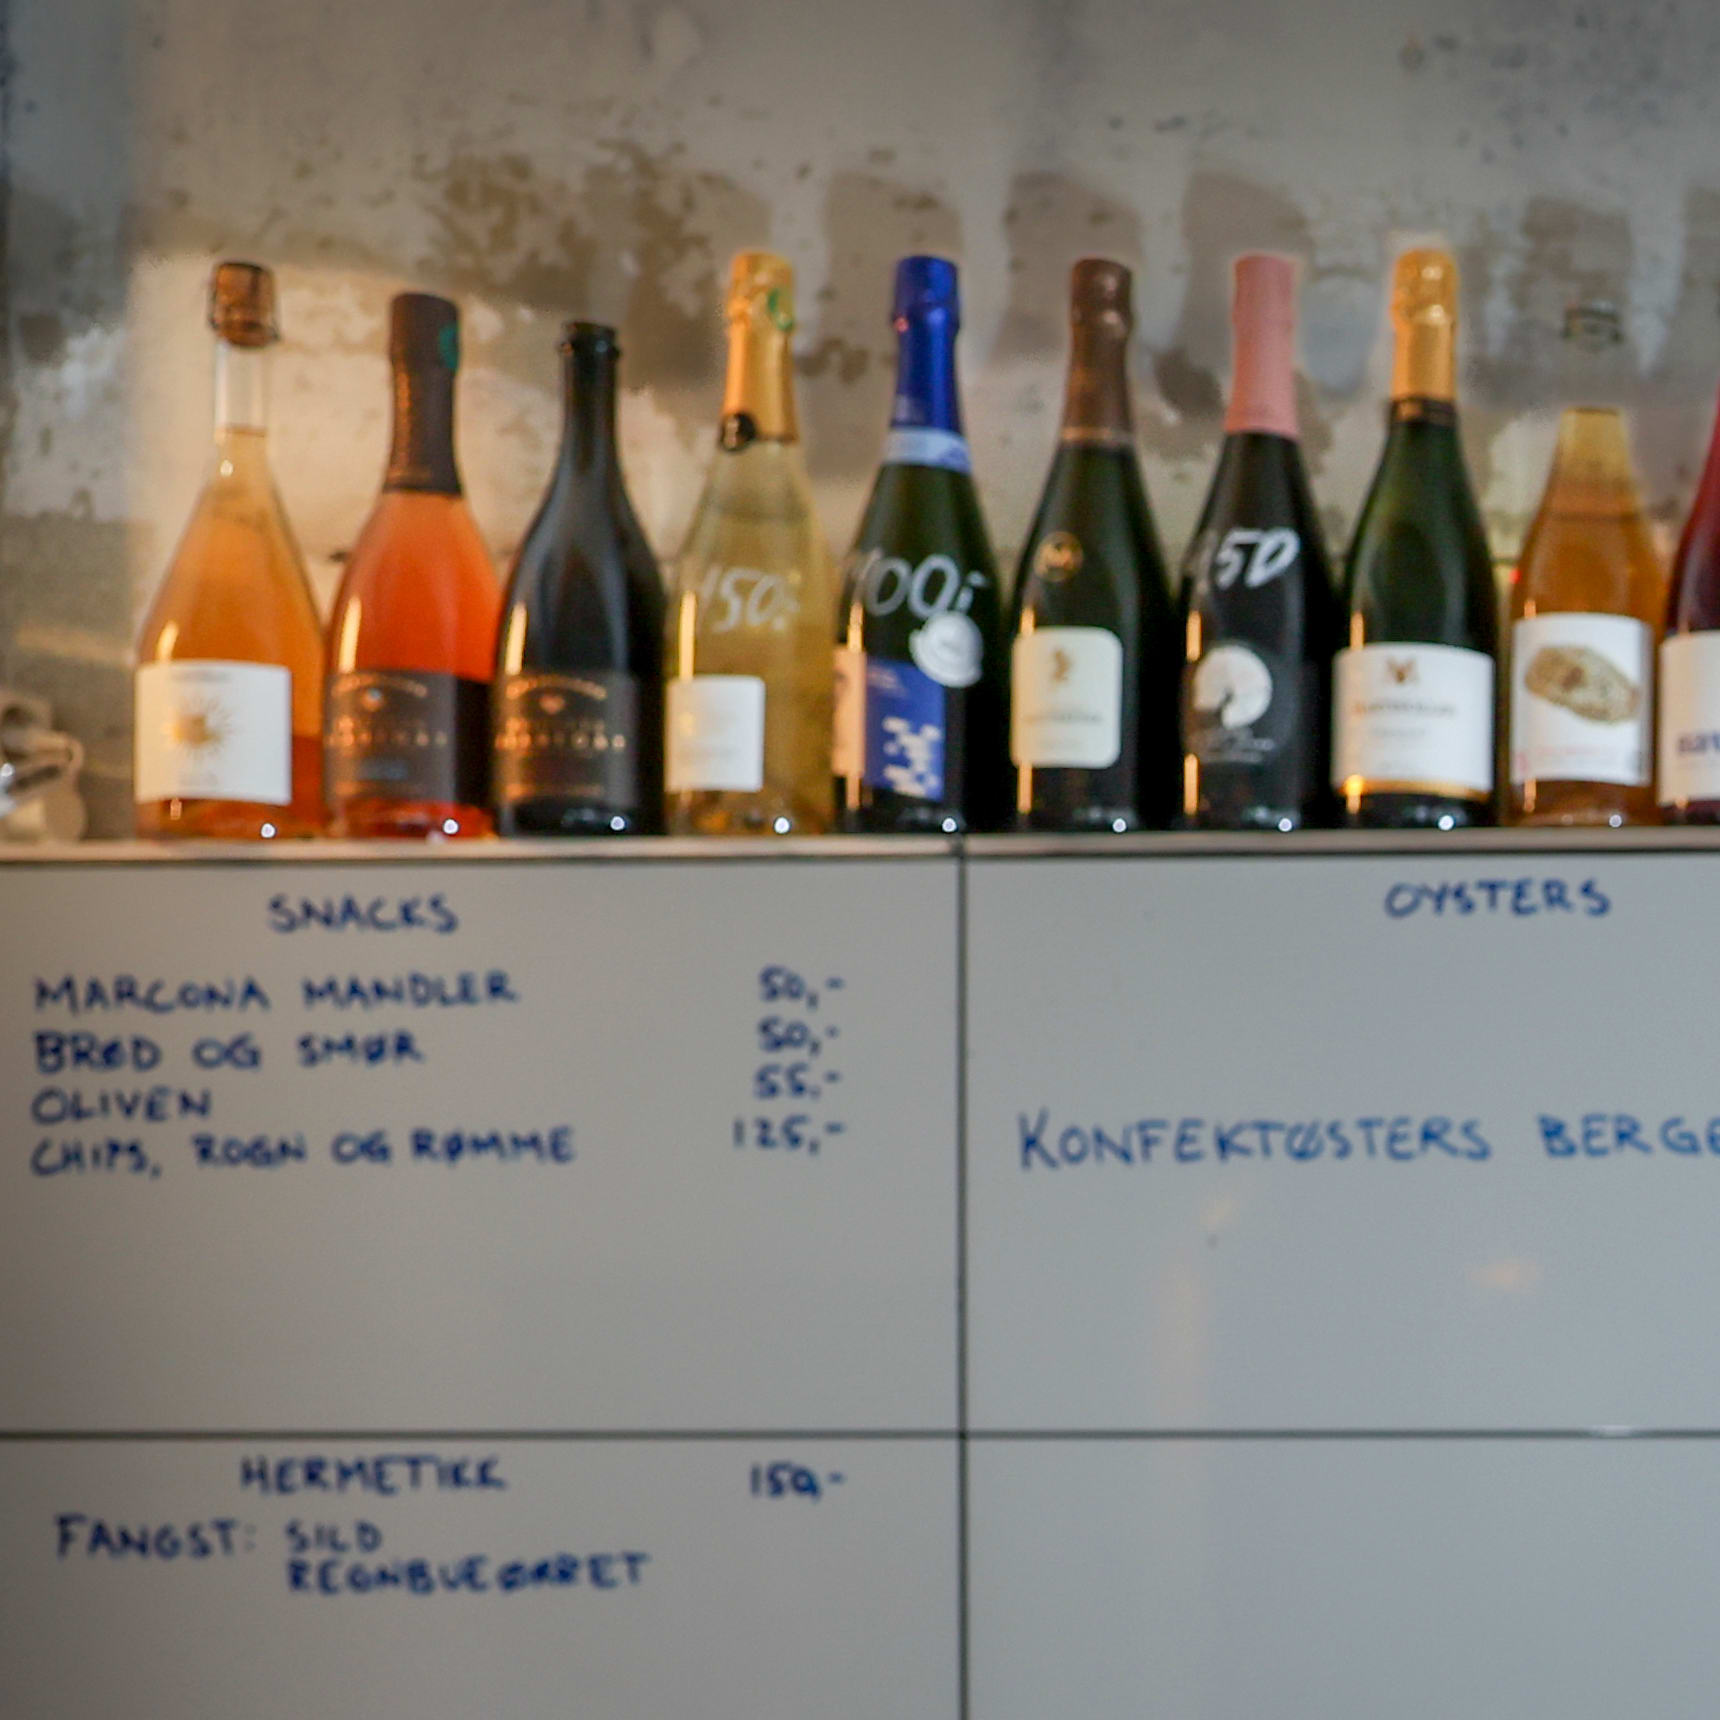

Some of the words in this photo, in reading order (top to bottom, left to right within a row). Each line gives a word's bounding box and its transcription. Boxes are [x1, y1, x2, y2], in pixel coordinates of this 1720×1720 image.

[268, 895, 458, 934] SNACKS
[1384, 878, 1611, 919] OYSTERS
[35, 975, 269, 1014] MARCONA
[303, 971, 515, 1007] MANDLER
[191, 1033, 262, 1069] OG
[31, 1087, 211, 1126] OLIVEN
[29, 1137, 162, 1179] CHIPS,
[192, 1134, 306, 1167] ROGN
[331, 1131, 391, 1164] OG
[1019, 1110, 1491, 1170] KONFEKTØSTERS
[241, 1455, 504, 1495] HERMETIKK
[285, 1520, 382, 1554] SILD
